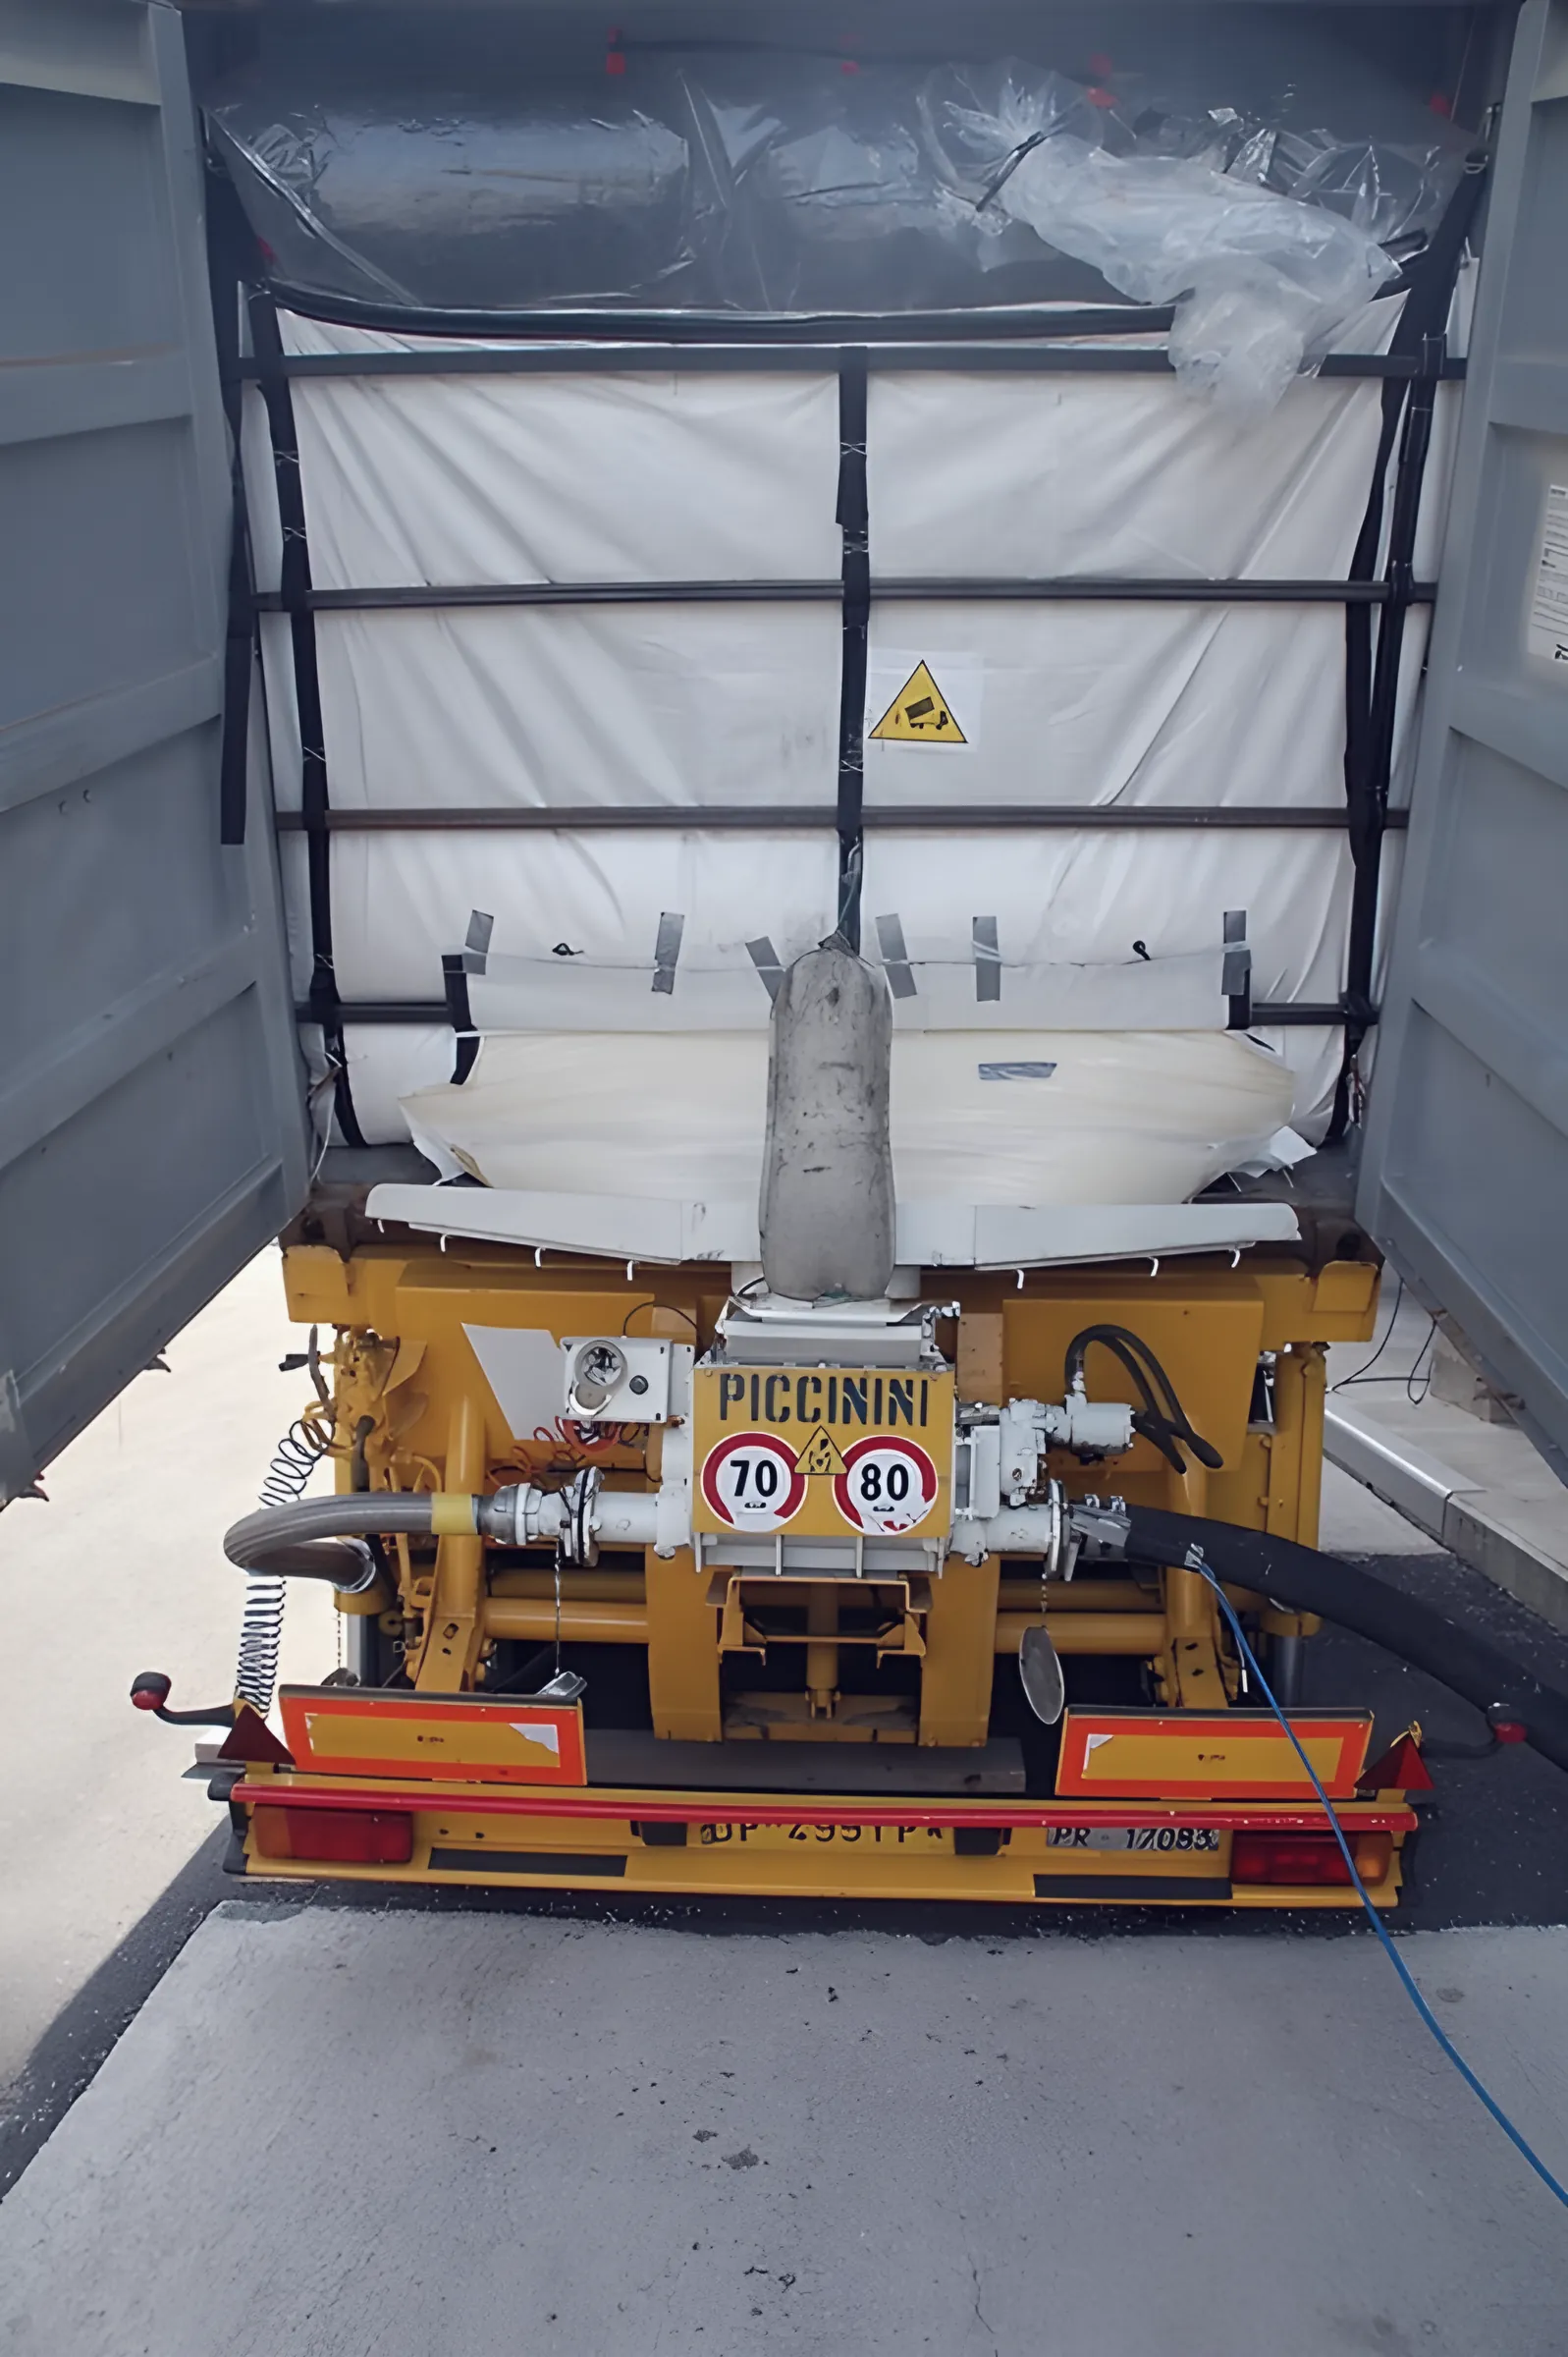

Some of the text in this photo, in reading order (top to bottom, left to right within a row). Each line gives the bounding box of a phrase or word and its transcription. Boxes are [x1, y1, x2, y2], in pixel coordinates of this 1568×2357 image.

[719, 1372, 929, 1427] PICCININI
[730, 1459, 779, 1498] 70
[860, 1462, 909, 1502] 80
